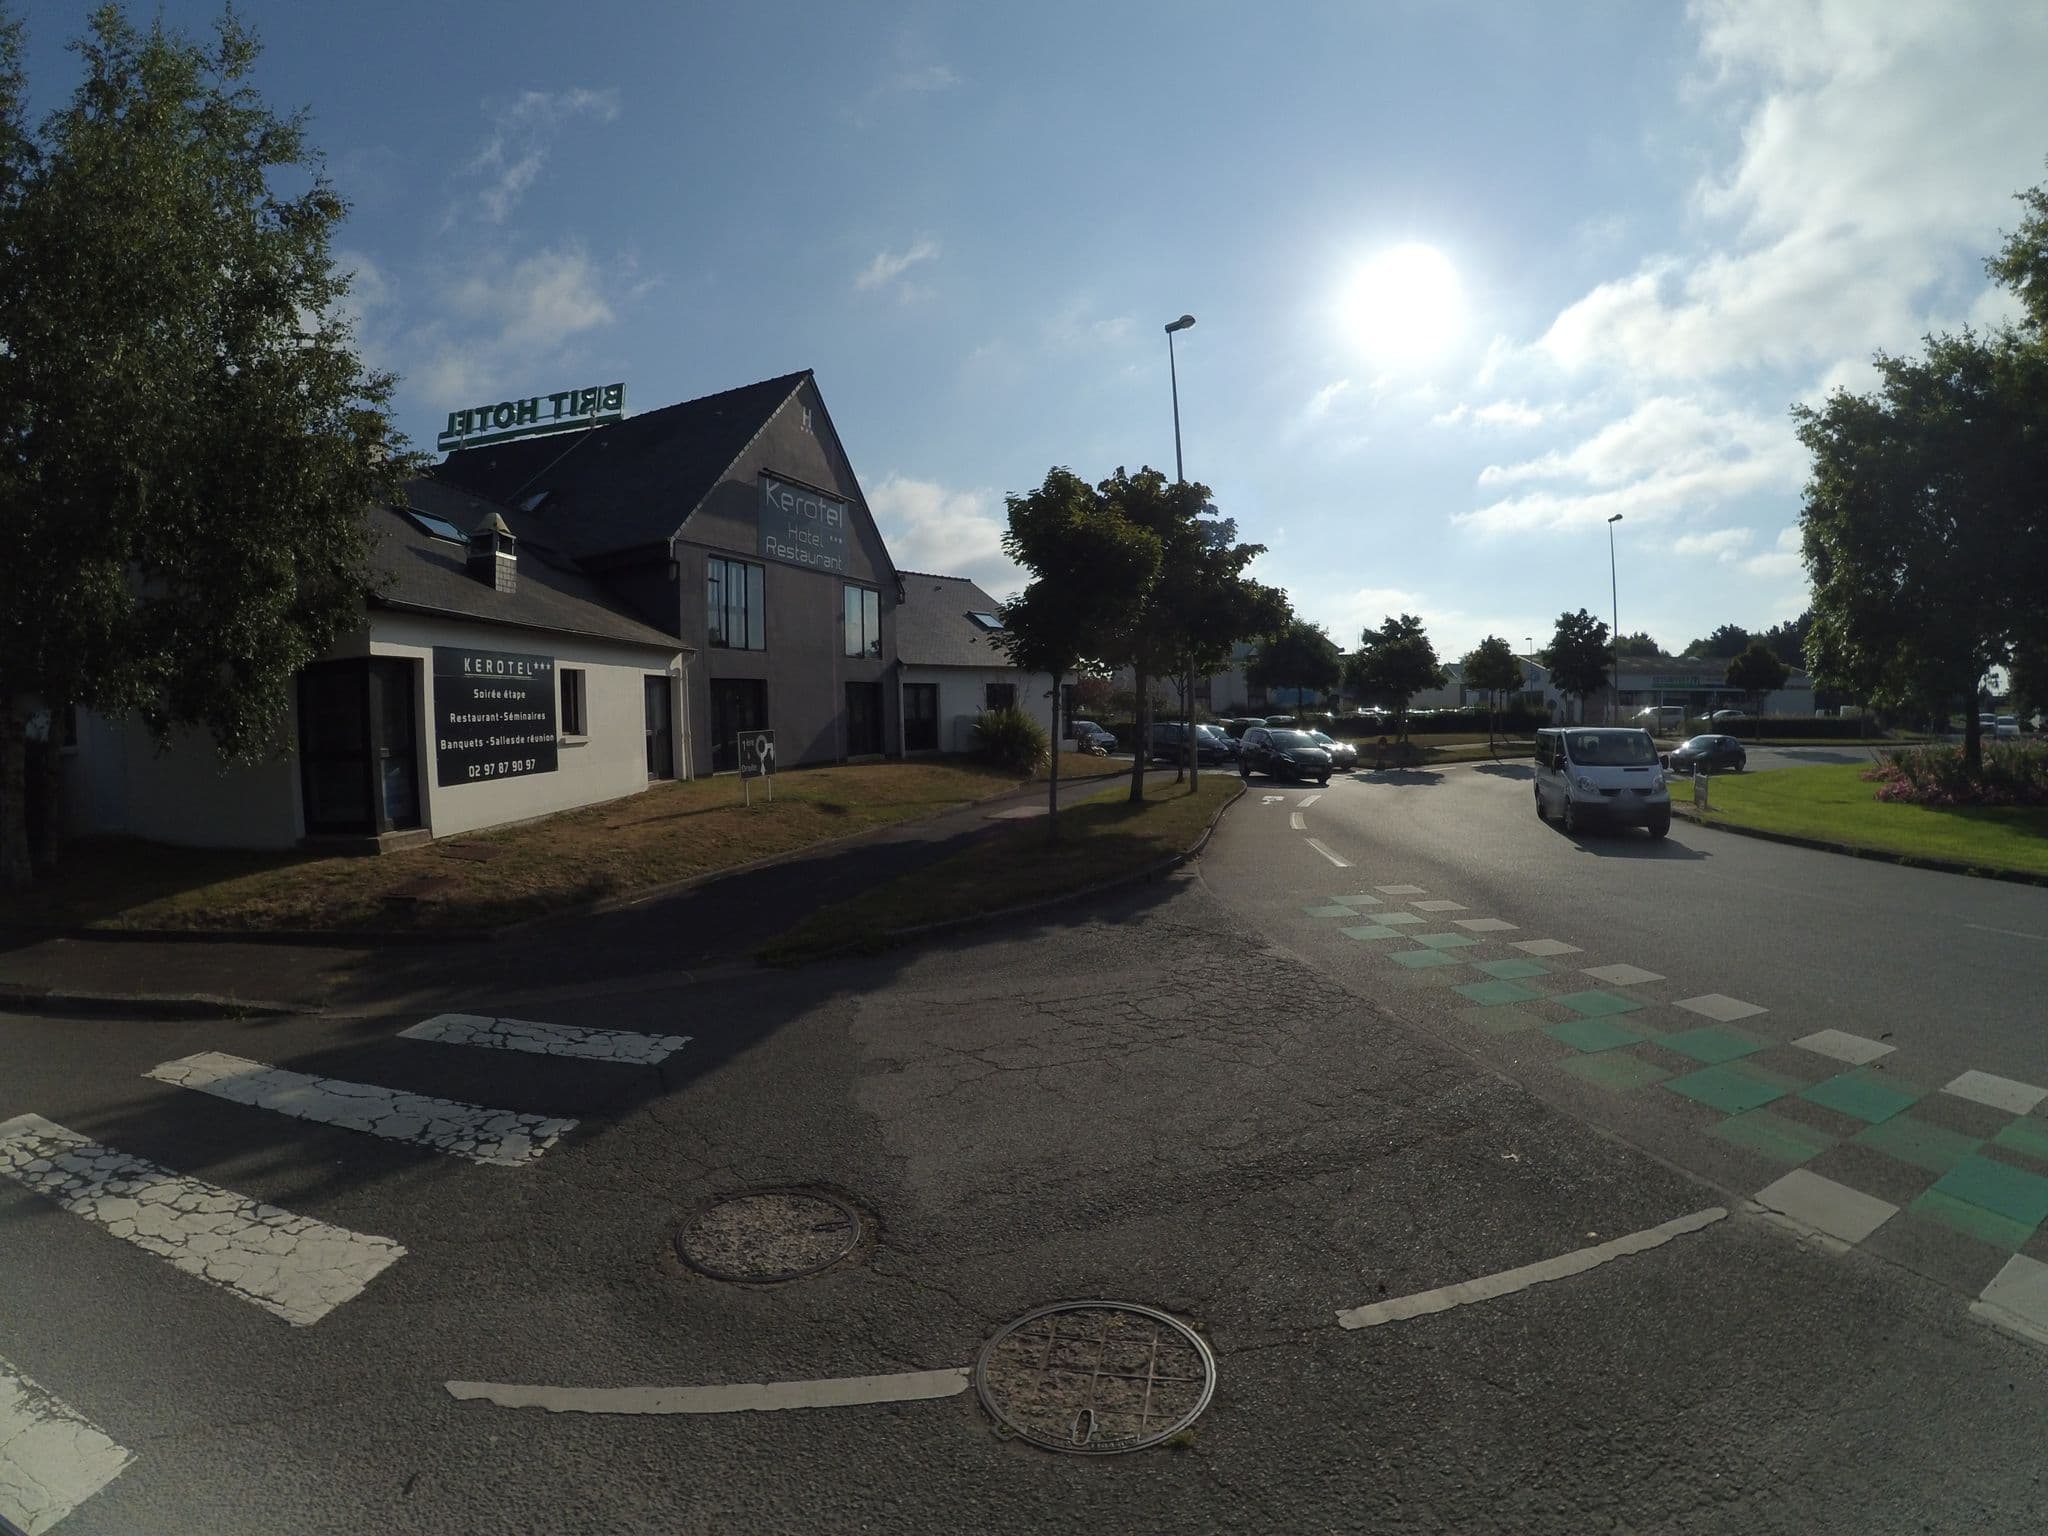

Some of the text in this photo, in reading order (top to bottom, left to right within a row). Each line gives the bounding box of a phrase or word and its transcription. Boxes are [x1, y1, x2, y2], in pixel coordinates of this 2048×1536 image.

[766, 478, 842, 528] Kerotel
[766, 536, 842, 571] Restaurant
[473, 689, 526, 701] Soirée étape
[440, 738, 484, 751] Banquets
[527, 733, 555, 744] réunion
[468, 759, 536, 778] 02 97 87 90 97
